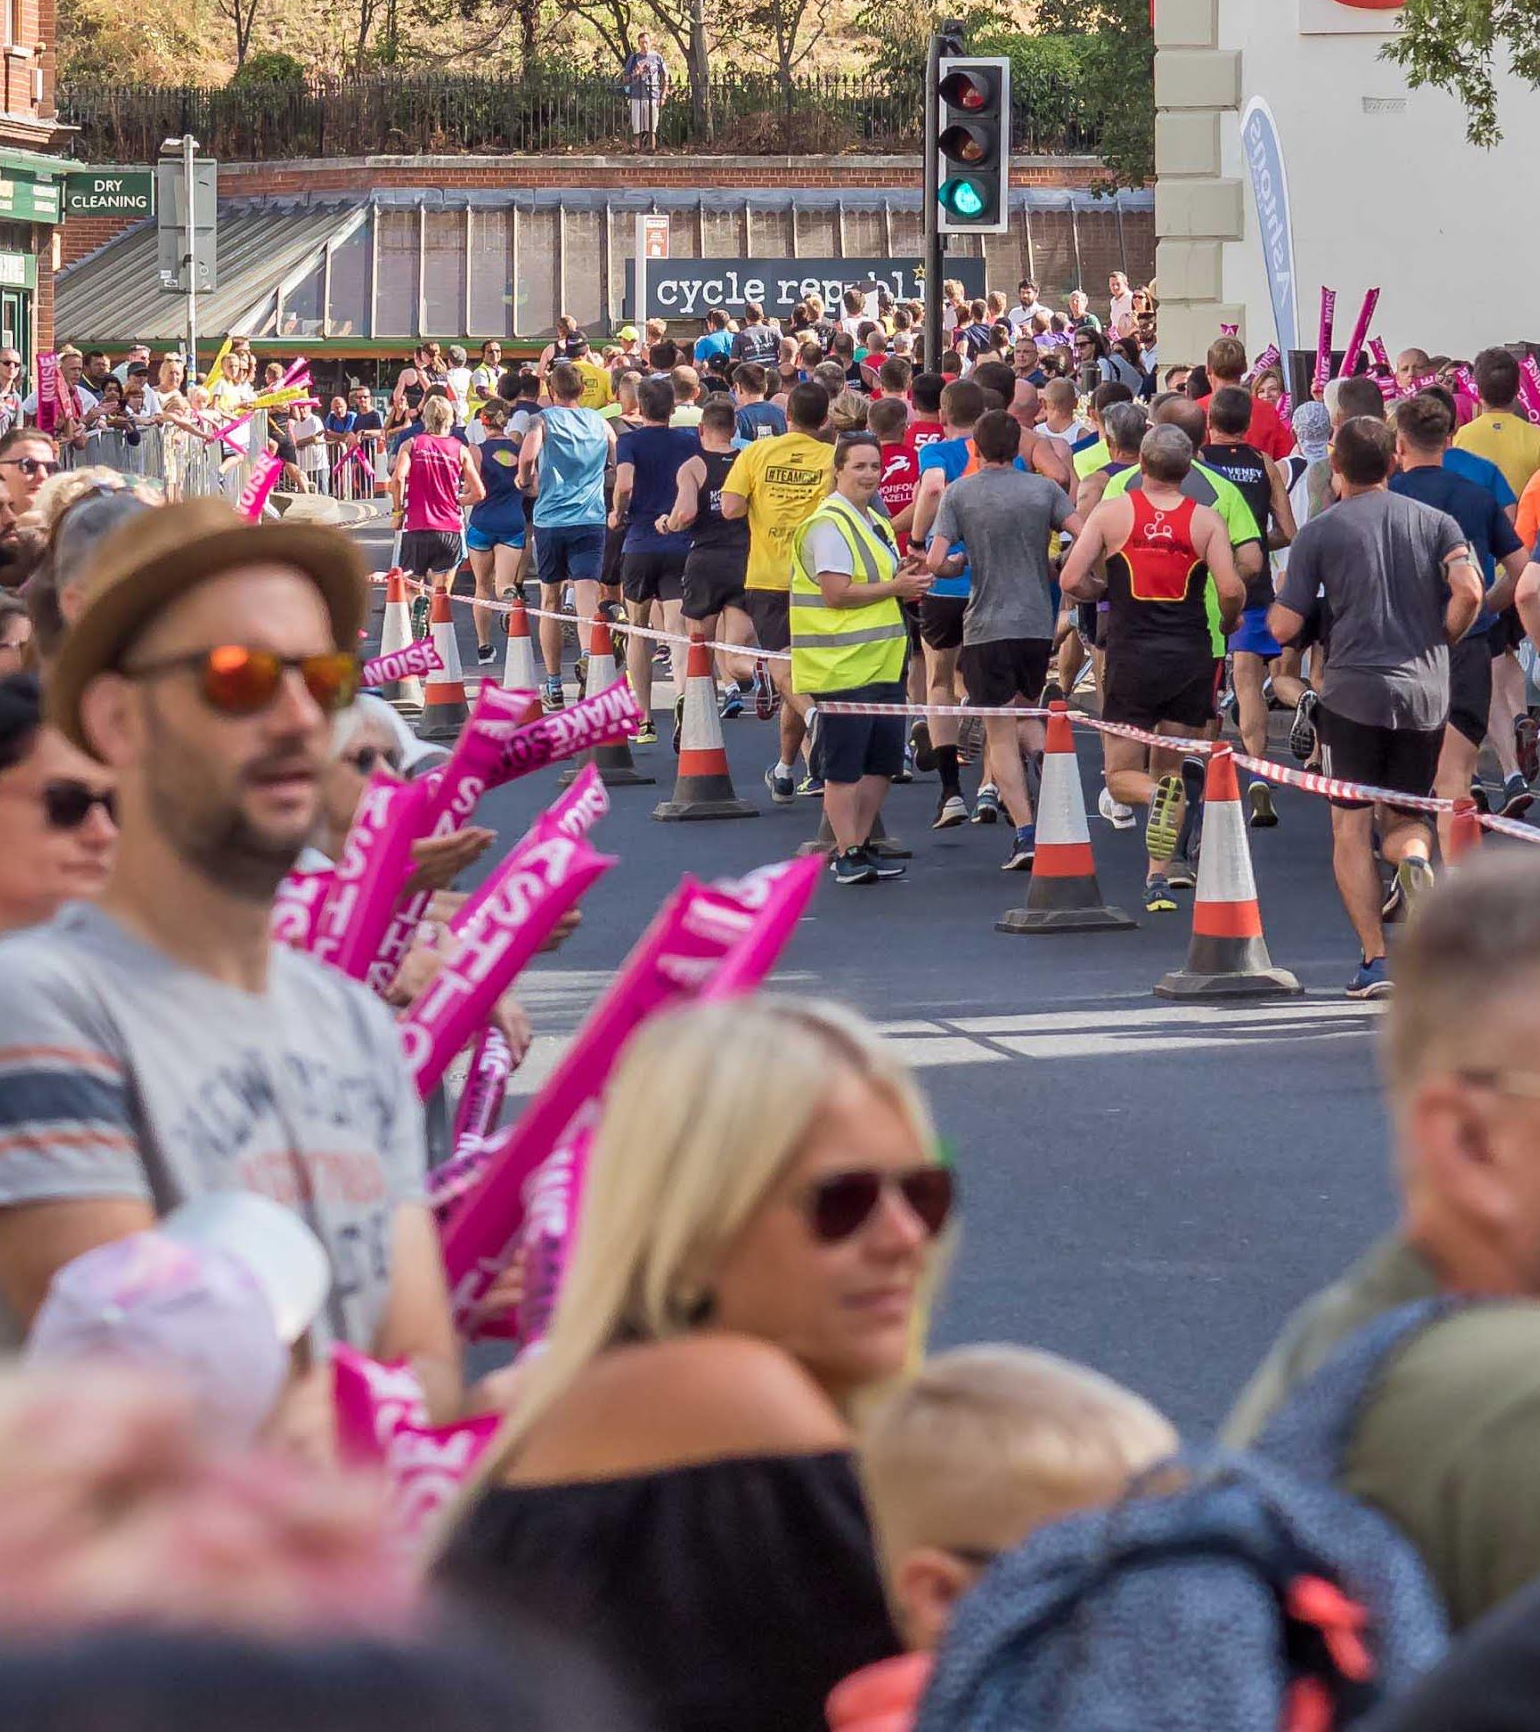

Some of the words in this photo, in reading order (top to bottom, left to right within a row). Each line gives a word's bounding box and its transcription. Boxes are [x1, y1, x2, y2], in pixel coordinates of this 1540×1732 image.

[94, 179, 123, 192] DRY
[71, 196, 147, 208] CLEANING
[656, 271, 765, 314] cycle
[776, 271, 929, 314] repbli
[40, 354, 58, 402] NOISE
[769, 469, 820, 484] #TEAM
[883, 493, 912, 503] AZELL
[364, 643, 441, 687] NOISE
